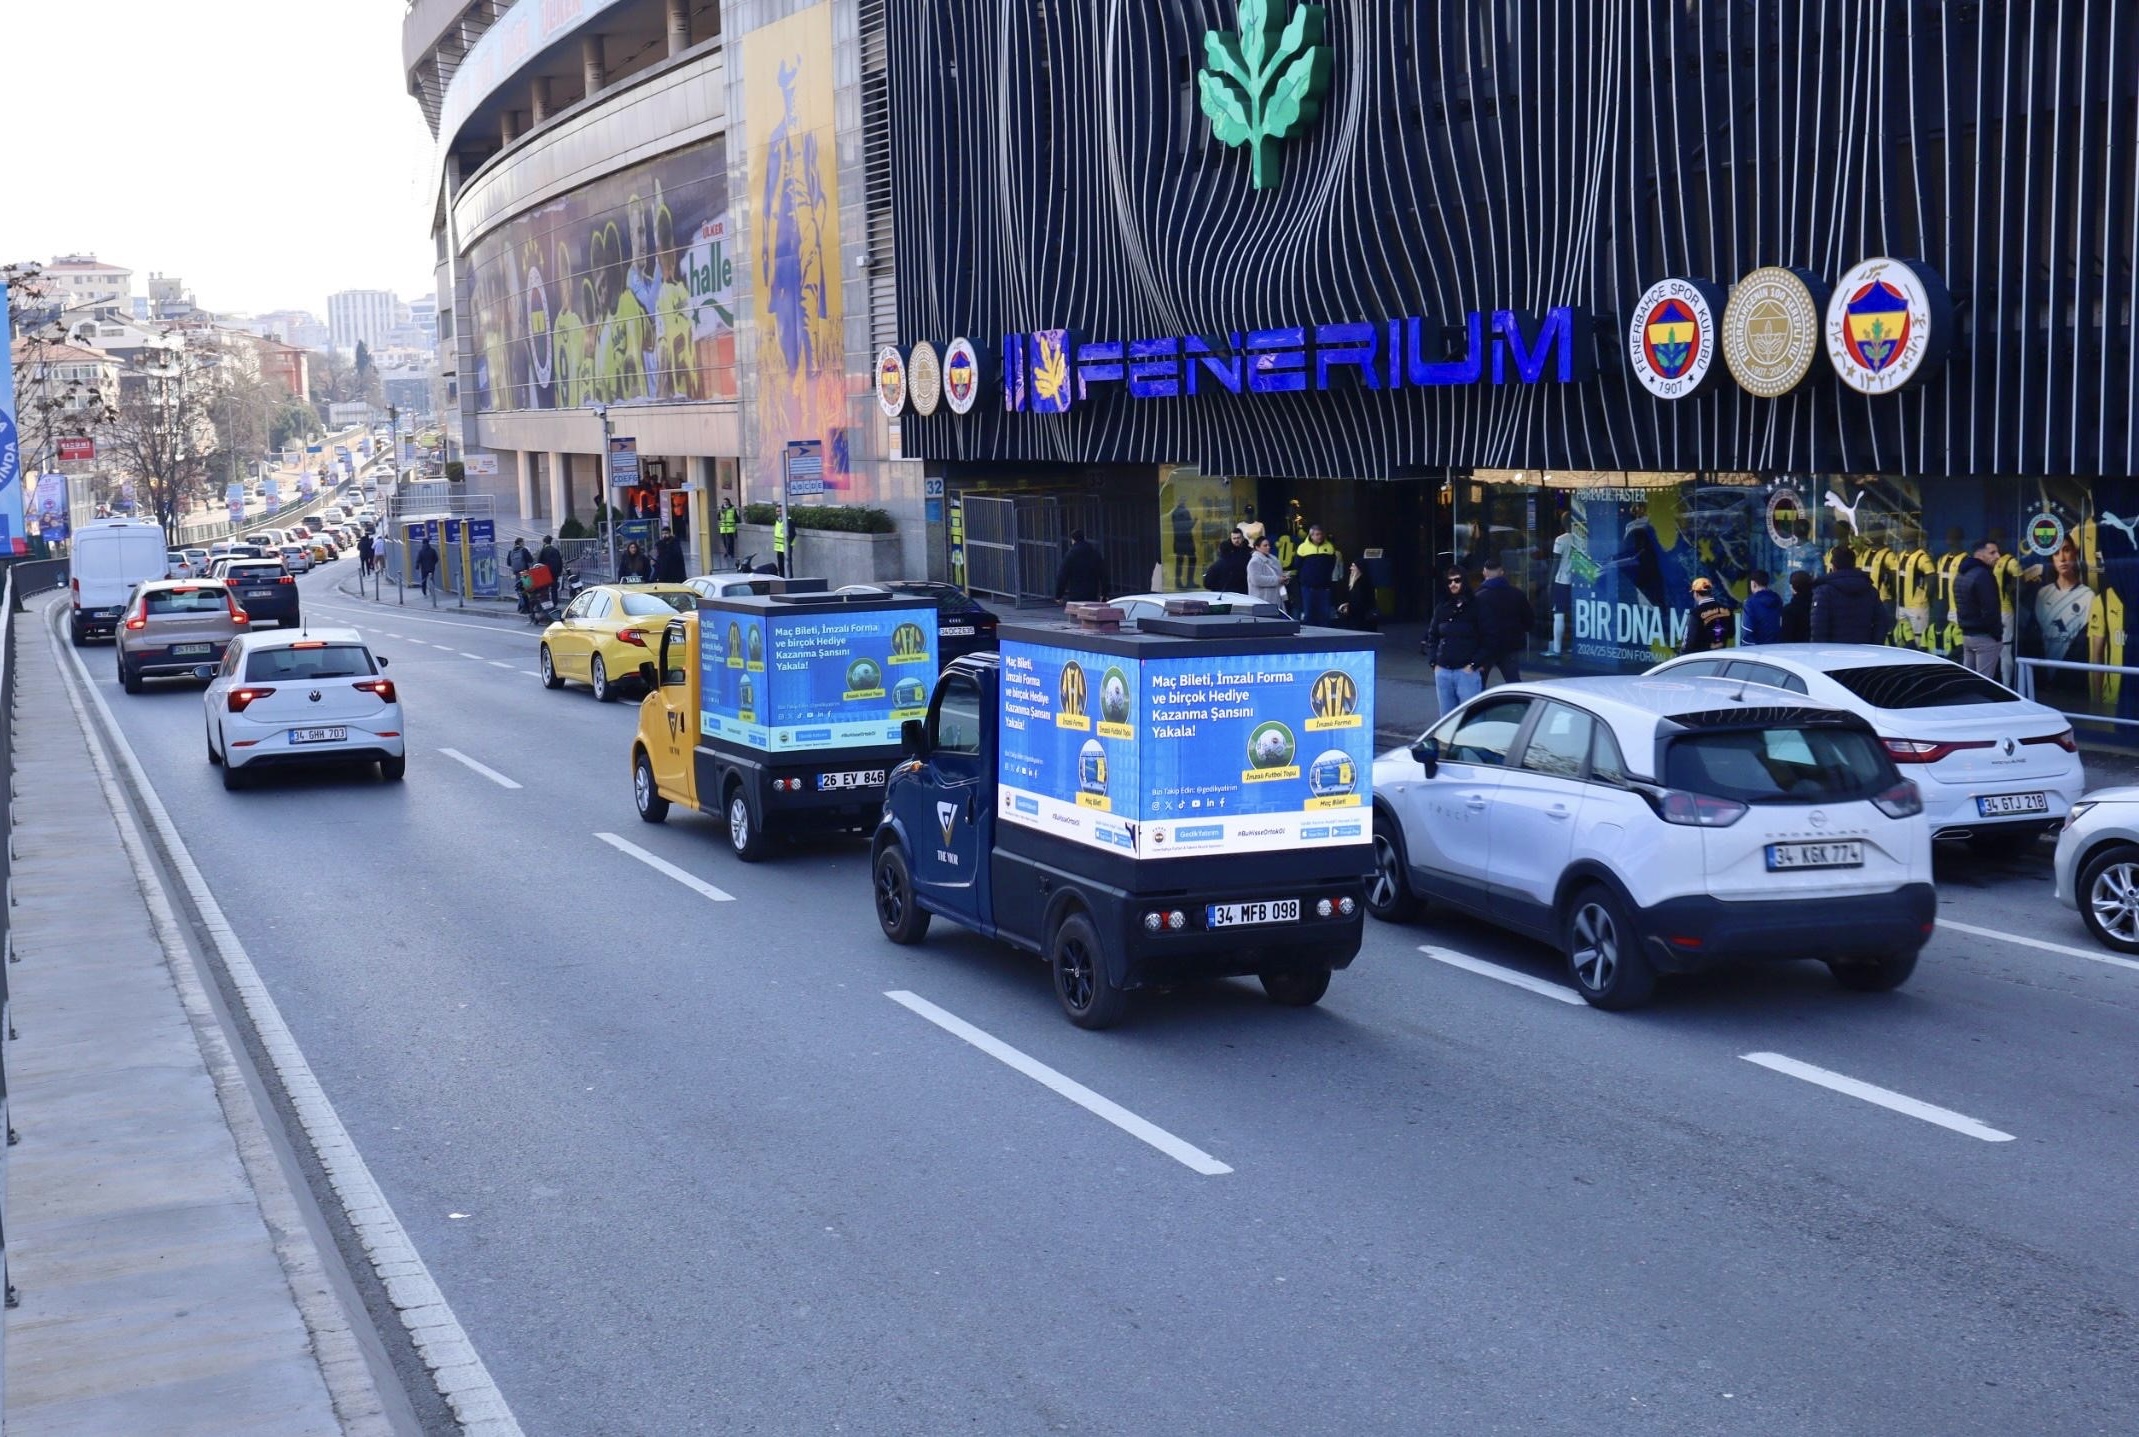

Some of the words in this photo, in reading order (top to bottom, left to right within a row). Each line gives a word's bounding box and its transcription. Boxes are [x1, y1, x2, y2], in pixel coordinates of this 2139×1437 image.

[702, 221, 724, 239] ÜLKER
[689, 240, 732, 298] halle
[1770, 288, 1786, 300] 100
[1633, 284, 1666, 373] FENERBAHÇE
[1670, 283, 1700, 308] SPOR
[1078, 305, 1573, 401] FENERIUM
[1659, 381, 1683, 395] 1907
[926, 480, 942, 495] 32
[1575, 591, 1612, 642] BİR
[1616, 602, 1666, 648] DNA
[775, 627, 793, 638] Maç
[795, 624, 821, 636] Bileti,
[821, 623, 850, 634] İmzalı
[850, 623, 878, 633] Forma
[775, 640, 787, 648] ve
[788, 638, 816, 649] birçok
[817, 636, 847, 648] Hediye
[776, 650, 817, 660] Kazanma
[818, 648, 850, 659] Şansını
[1577, 643, 1607, 658] 2024/25
[1607, 646, 1634, 660] SEZON
[776, 661, 809, 672] Yakala!
[1005, 655, 1017, 668] Maç
[1017, 657, 1033, 671] Bileti,
[1023, 674, 1041, 687] Forma
[1152, 675, 1177, 689] Maç
[1179, 673, 1214, 687] Bileti,
[1216, 670, 1254, 685] İmzalı
[1257, 671, 1294, 684] Forma
[1005, 688, 1012, 697] ve
[1030, 691, 1050, 705] Hediye
[1152, 694, 1167, 704] ve
[1169, 691, 1206, 706] birçok
[1208, 689, 1249, 703] Hediye
[1005, 702, 1030, 715] Kazanma
[1152, 709, 1208, 722] Kazanma
[1210, 706, 1254, 722] Şansını
[1005, 718, 1025, 730] Yakala!
[1152, 724, 1196, 739] Yakala!
[294, 731, 304, 741] 34
[328, 728, 345, 738] 703
[823, 774, 837, 786] 26
[843, 773, 858, 785] EV
[864, 771, 884, 783] 846
[1283, 769, 1297, 779] Topu
[1984, 797, 1999, 811] 34
[2002, 796, 2022, 810] GTJ
[2026, 794, 2044, 808] 218
[1775, 844, 1794, 865] 34
[1801, 844, 1828, 864] KGK
[1832, 843, 1859, 862] 774
[1216, 907, 1234, 924] 34
[1241, 904, 1267, 922] MFB
[1272, 901, 1297, 920] 098
